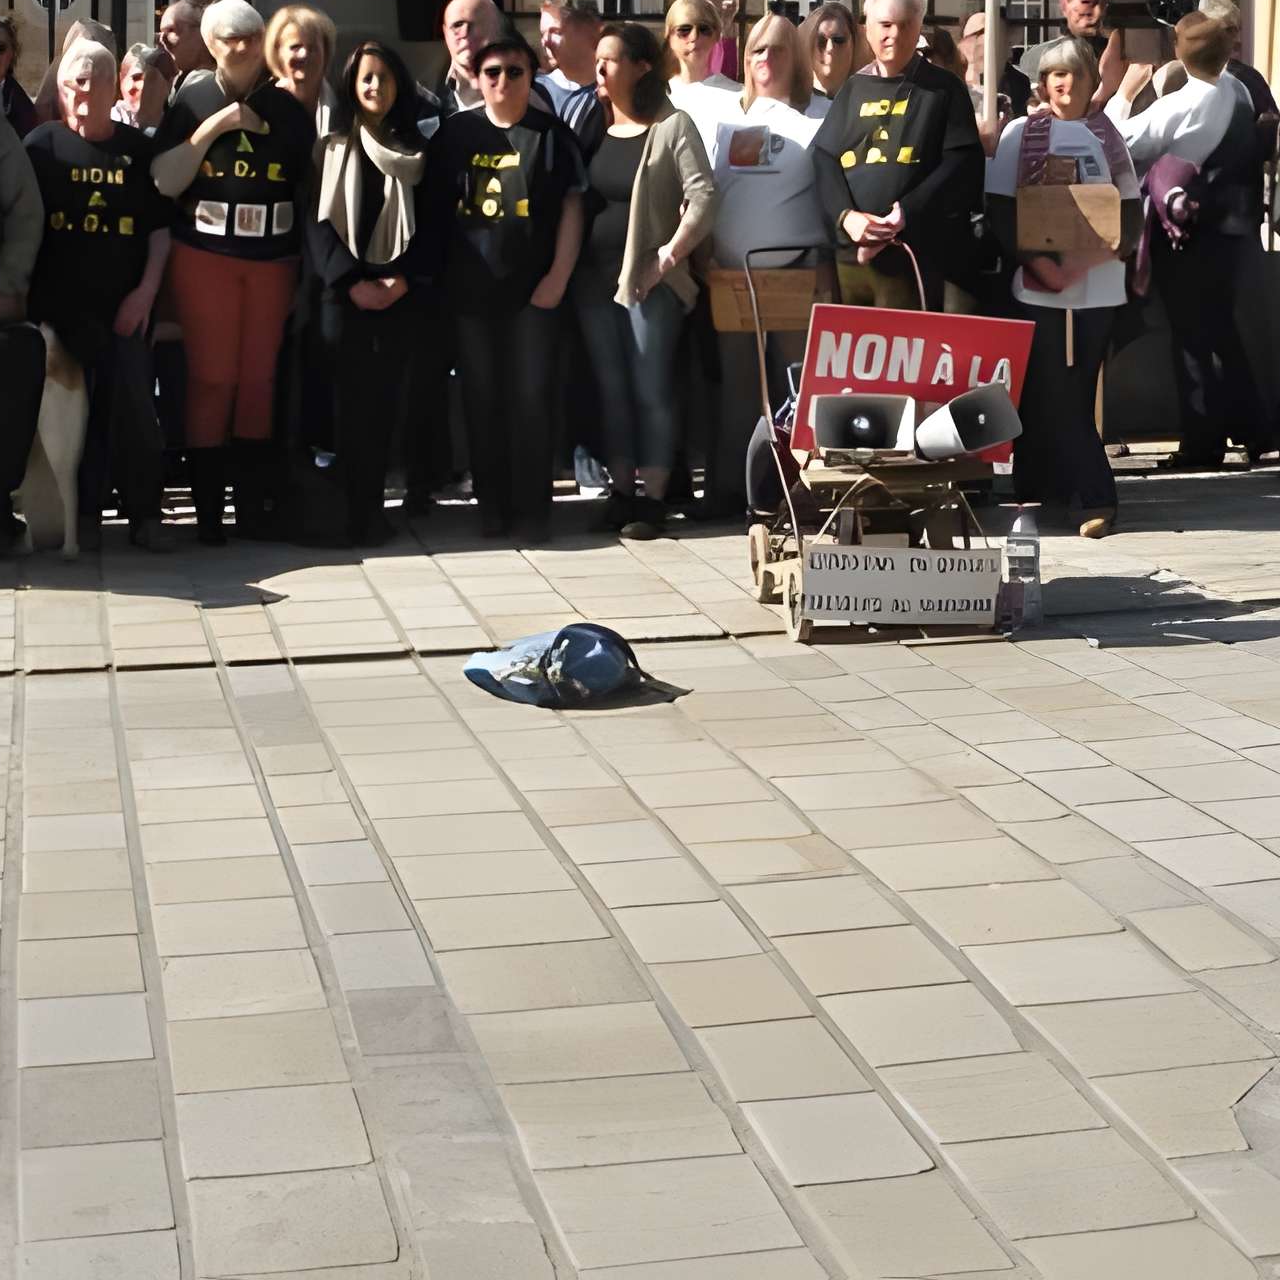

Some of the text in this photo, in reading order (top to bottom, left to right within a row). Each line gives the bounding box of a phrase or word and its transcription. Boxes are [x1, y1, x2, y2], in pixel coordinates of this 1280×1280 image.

[815, 330, 1012, 393] NON À LA
